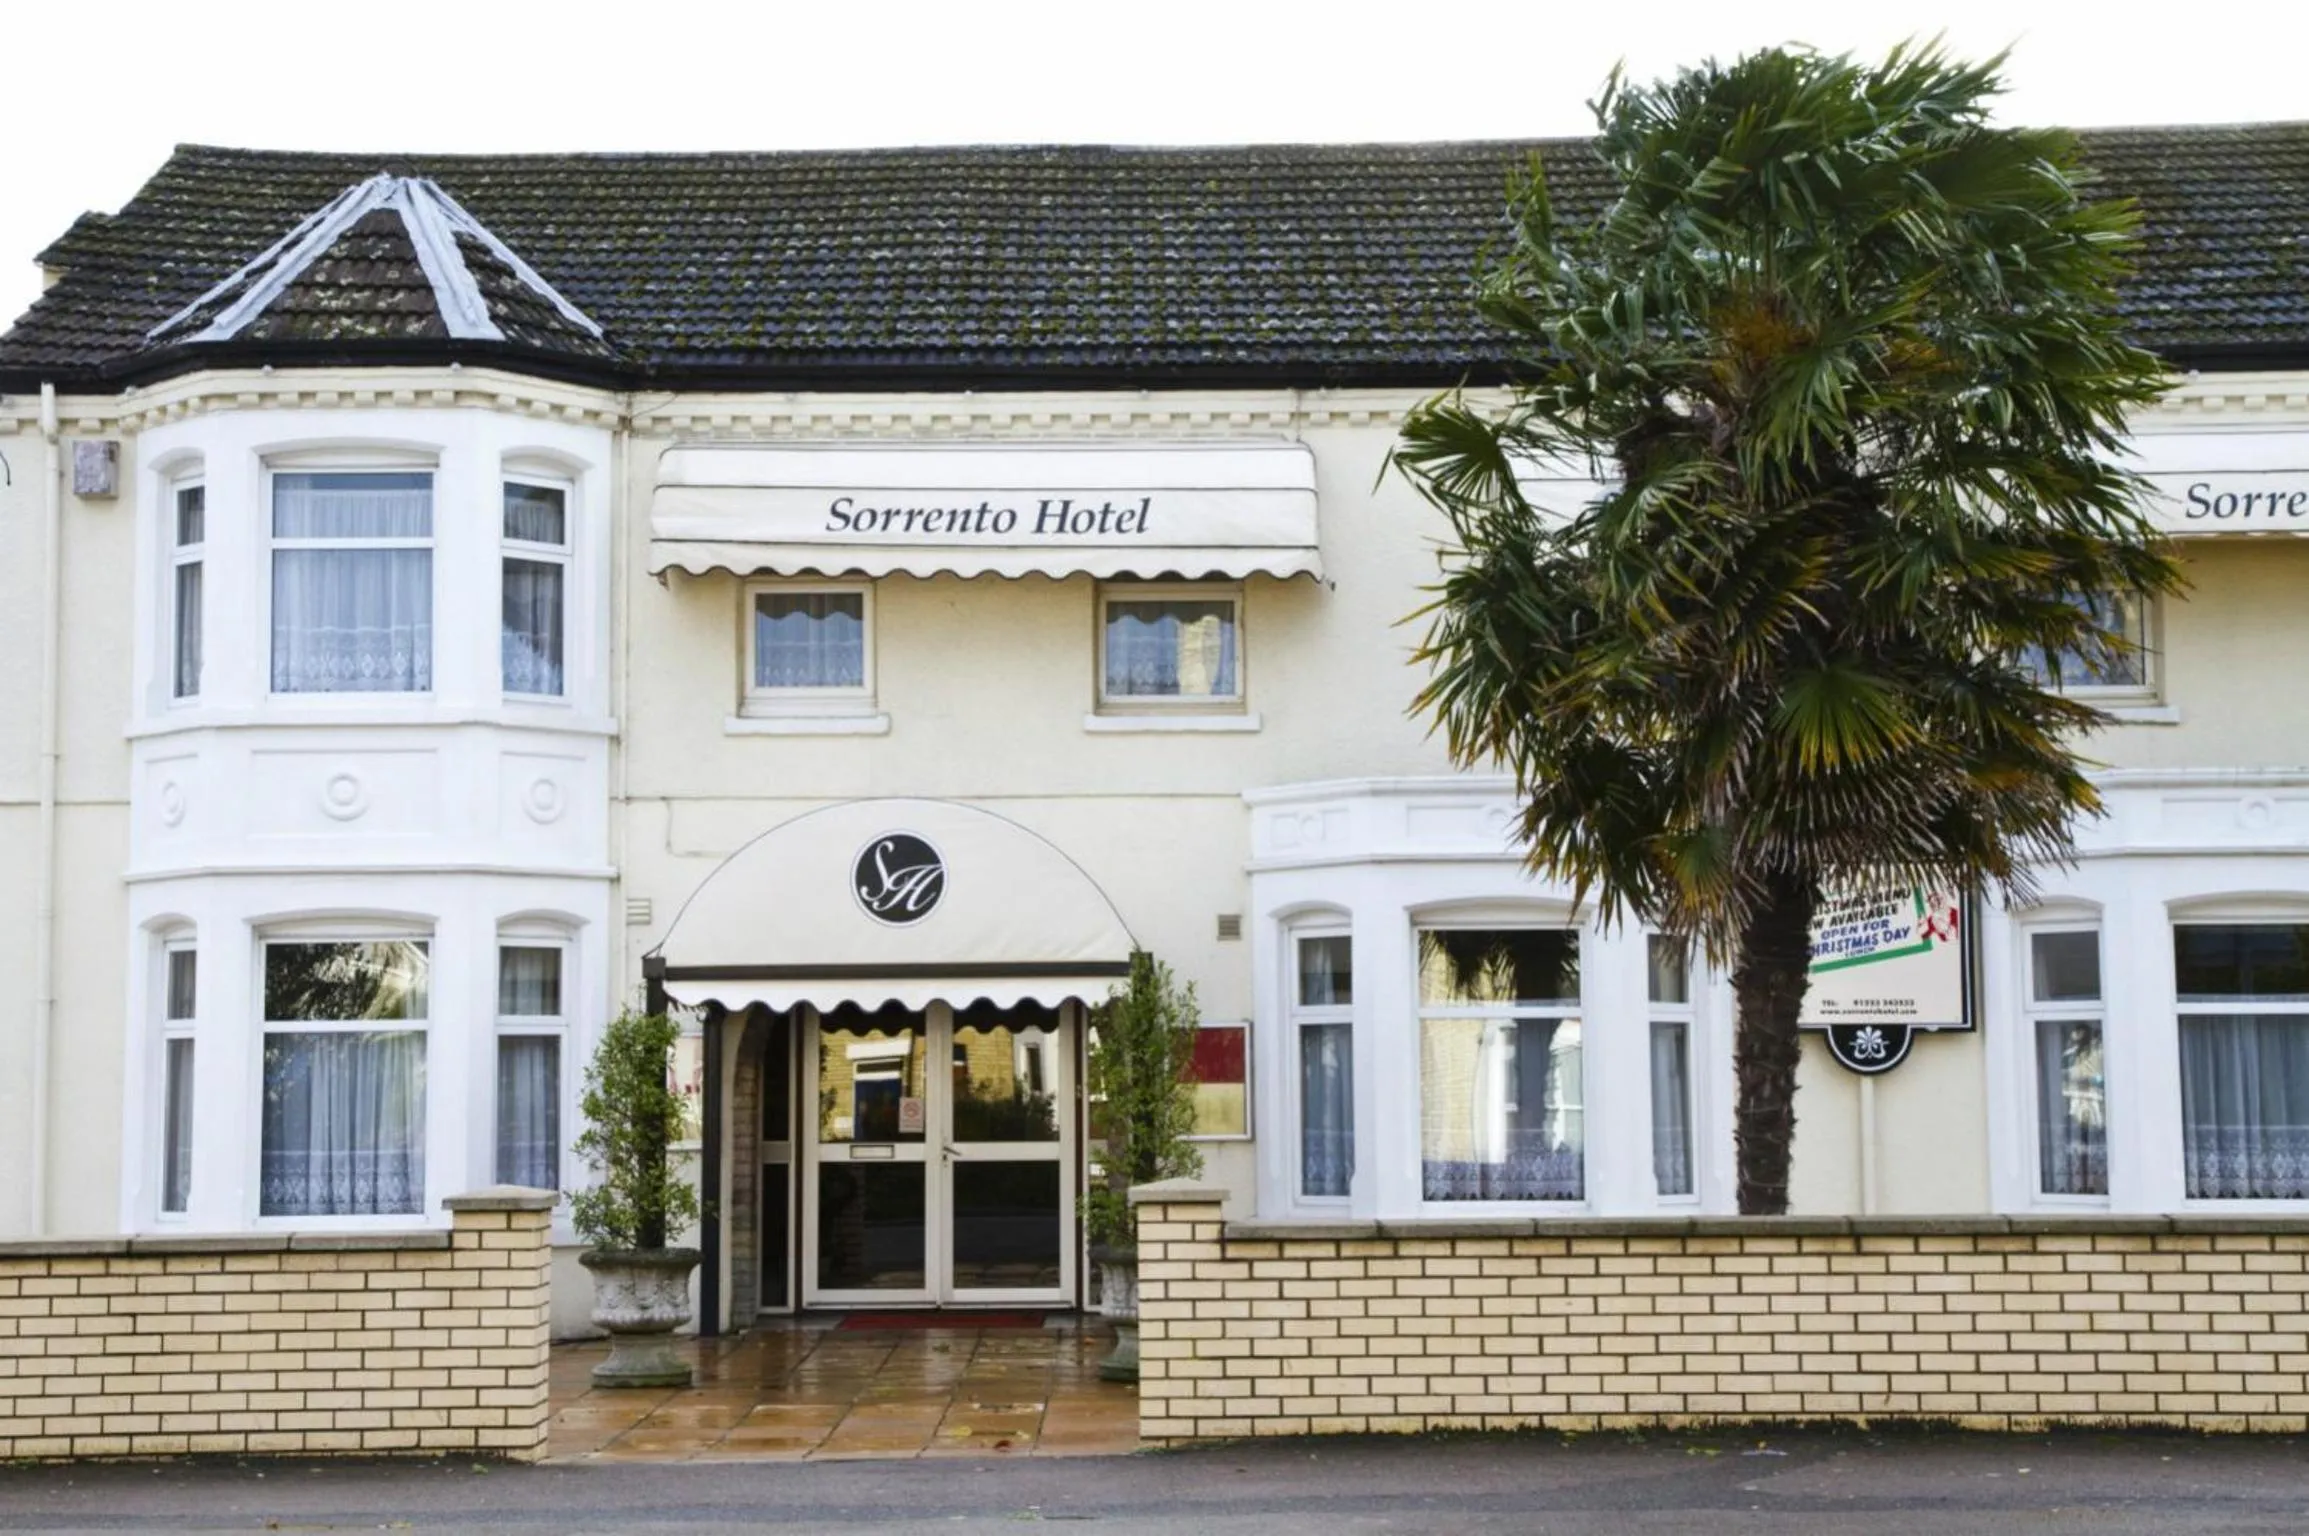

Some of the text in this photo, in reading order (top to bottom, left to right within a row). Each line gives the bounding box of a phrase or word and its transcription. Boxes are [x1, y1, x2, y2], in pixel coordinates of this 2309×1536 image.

[825, 496, 1152, 535] Sorrento Hotel
[1821, 919, 1890, 940] OPEN FOR
[1883, 925, 1911, 943] DAY
